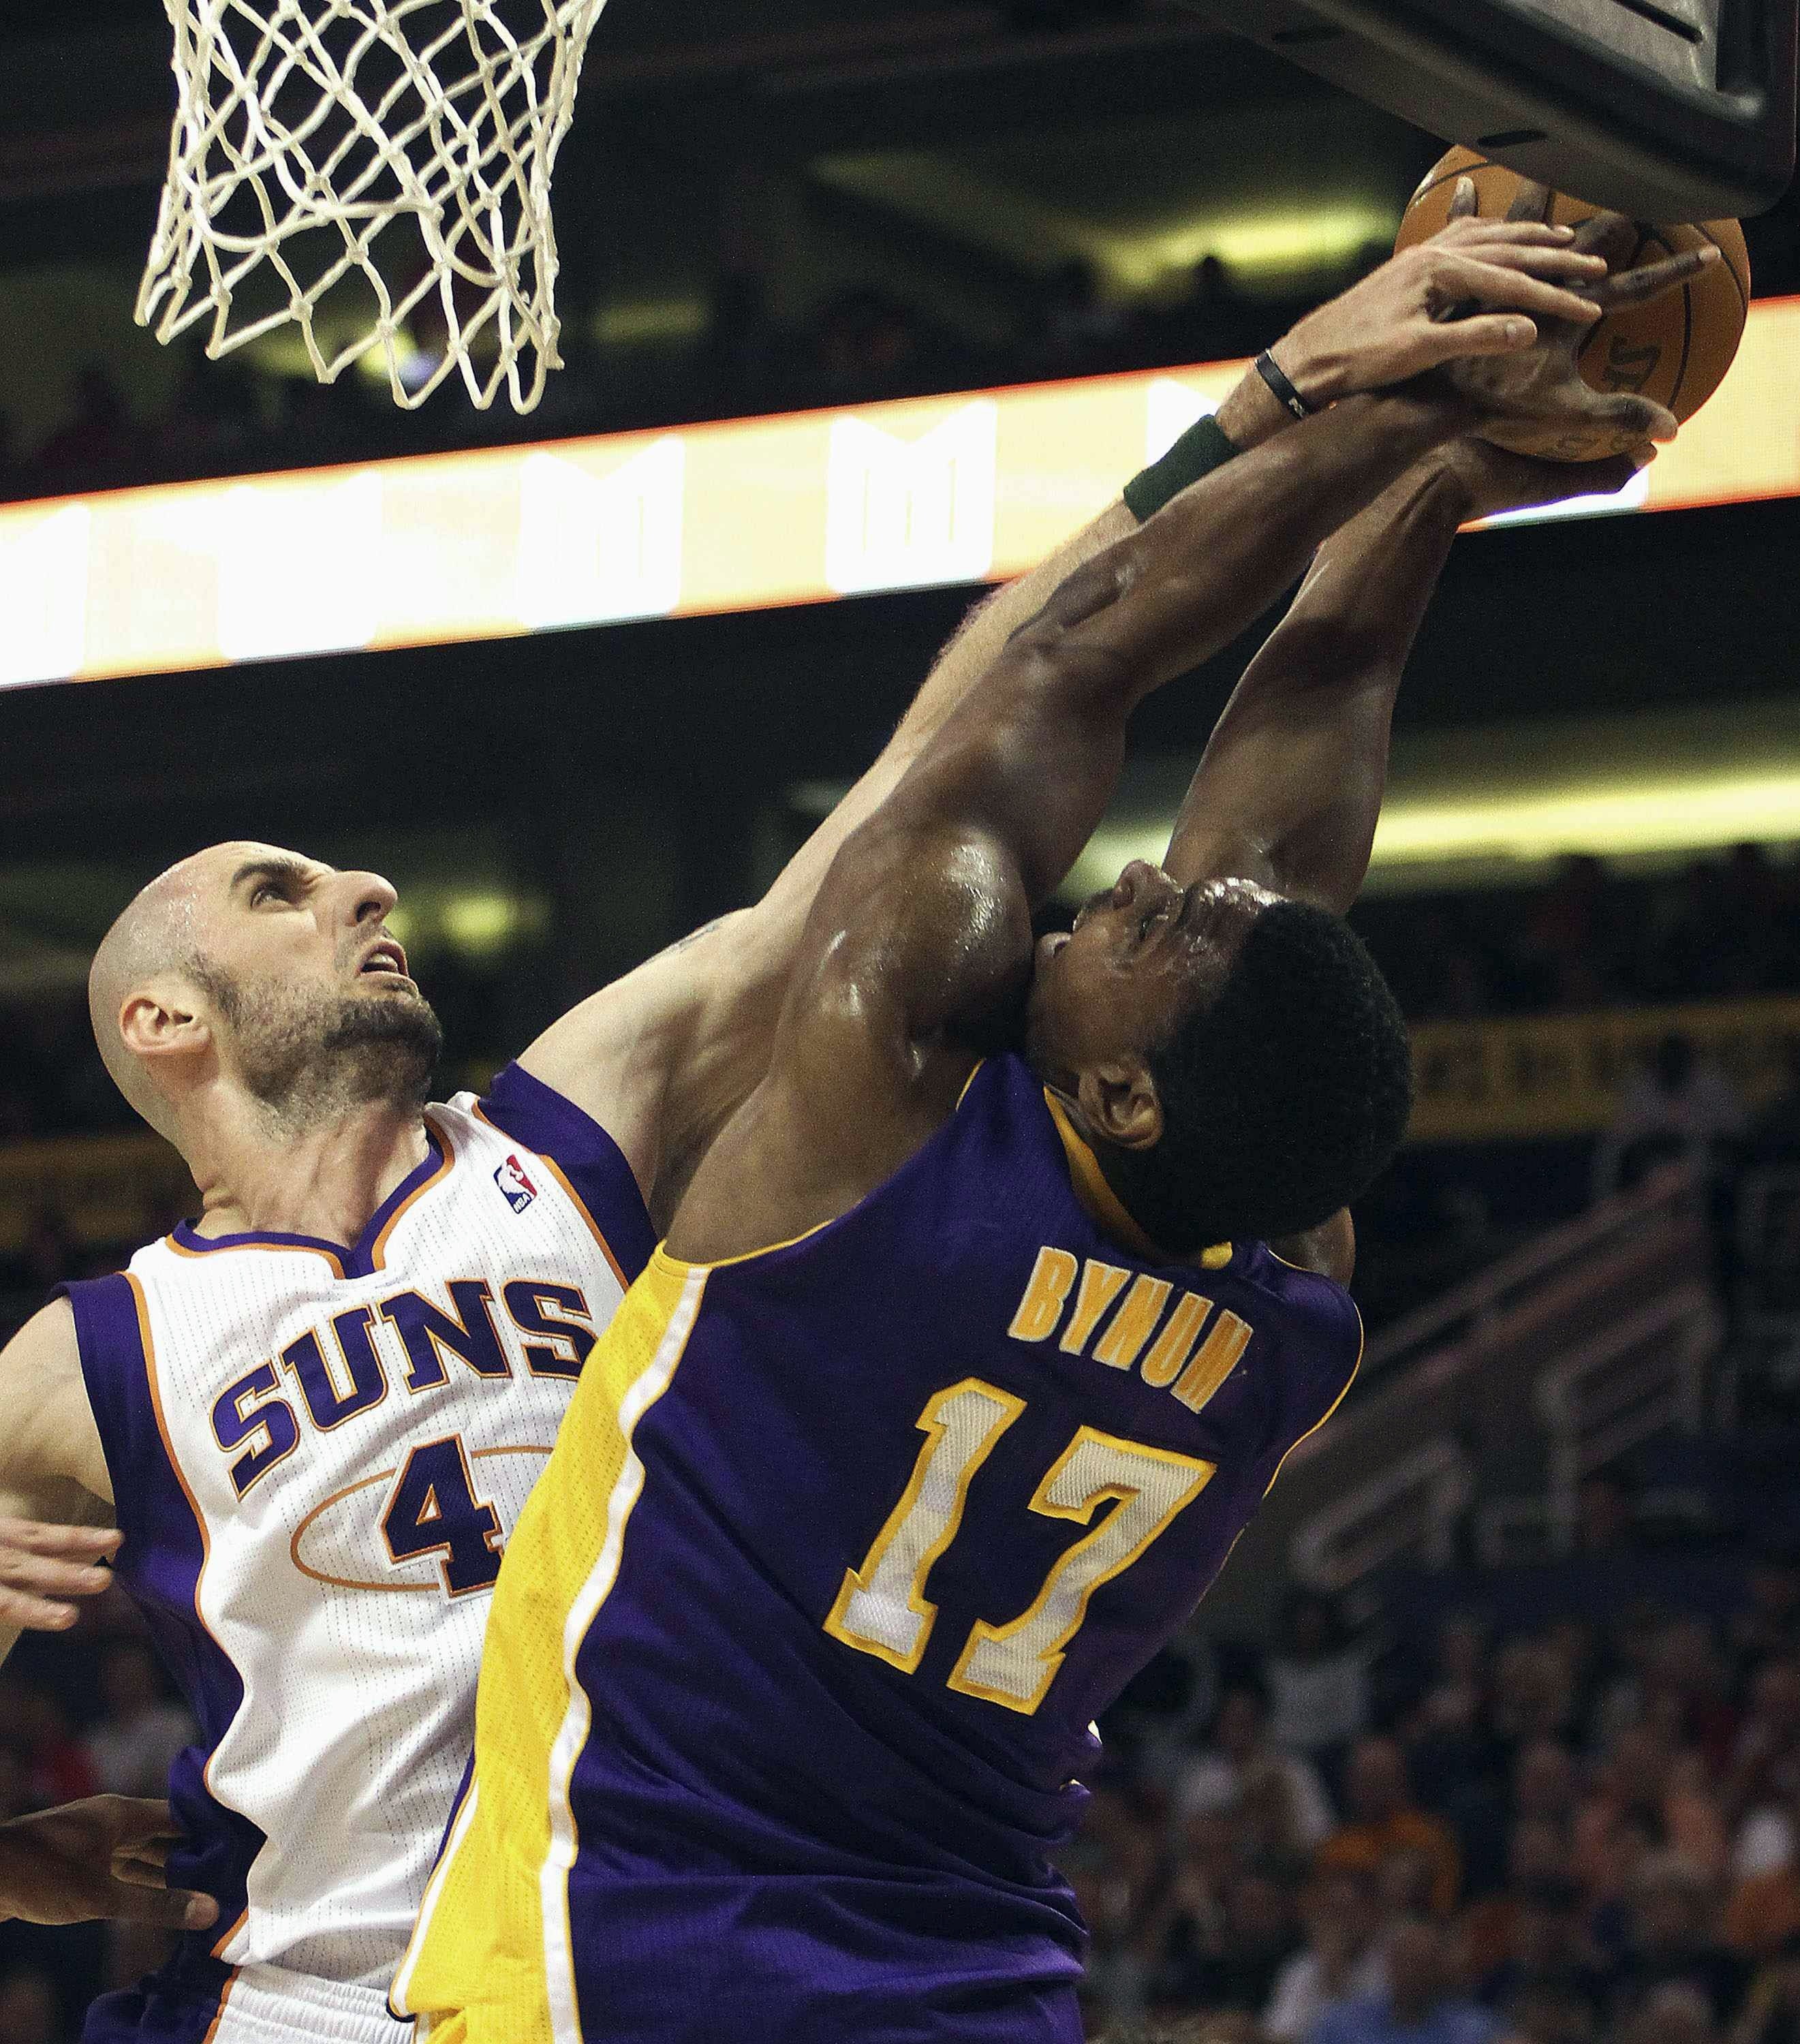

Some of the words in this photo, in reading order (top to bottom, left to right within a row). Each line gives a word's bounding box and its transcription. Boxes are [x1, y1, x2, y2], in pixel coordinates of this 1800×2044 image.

[512, 1193, 531, 1213] NBA
[208, 1278, 600, 1502] SUNS
[1007, 1245, 1254, 1414] BYNUM
[378, 1433, 504, 1598] 4
[822, 1376, 1217, 1716] 17
